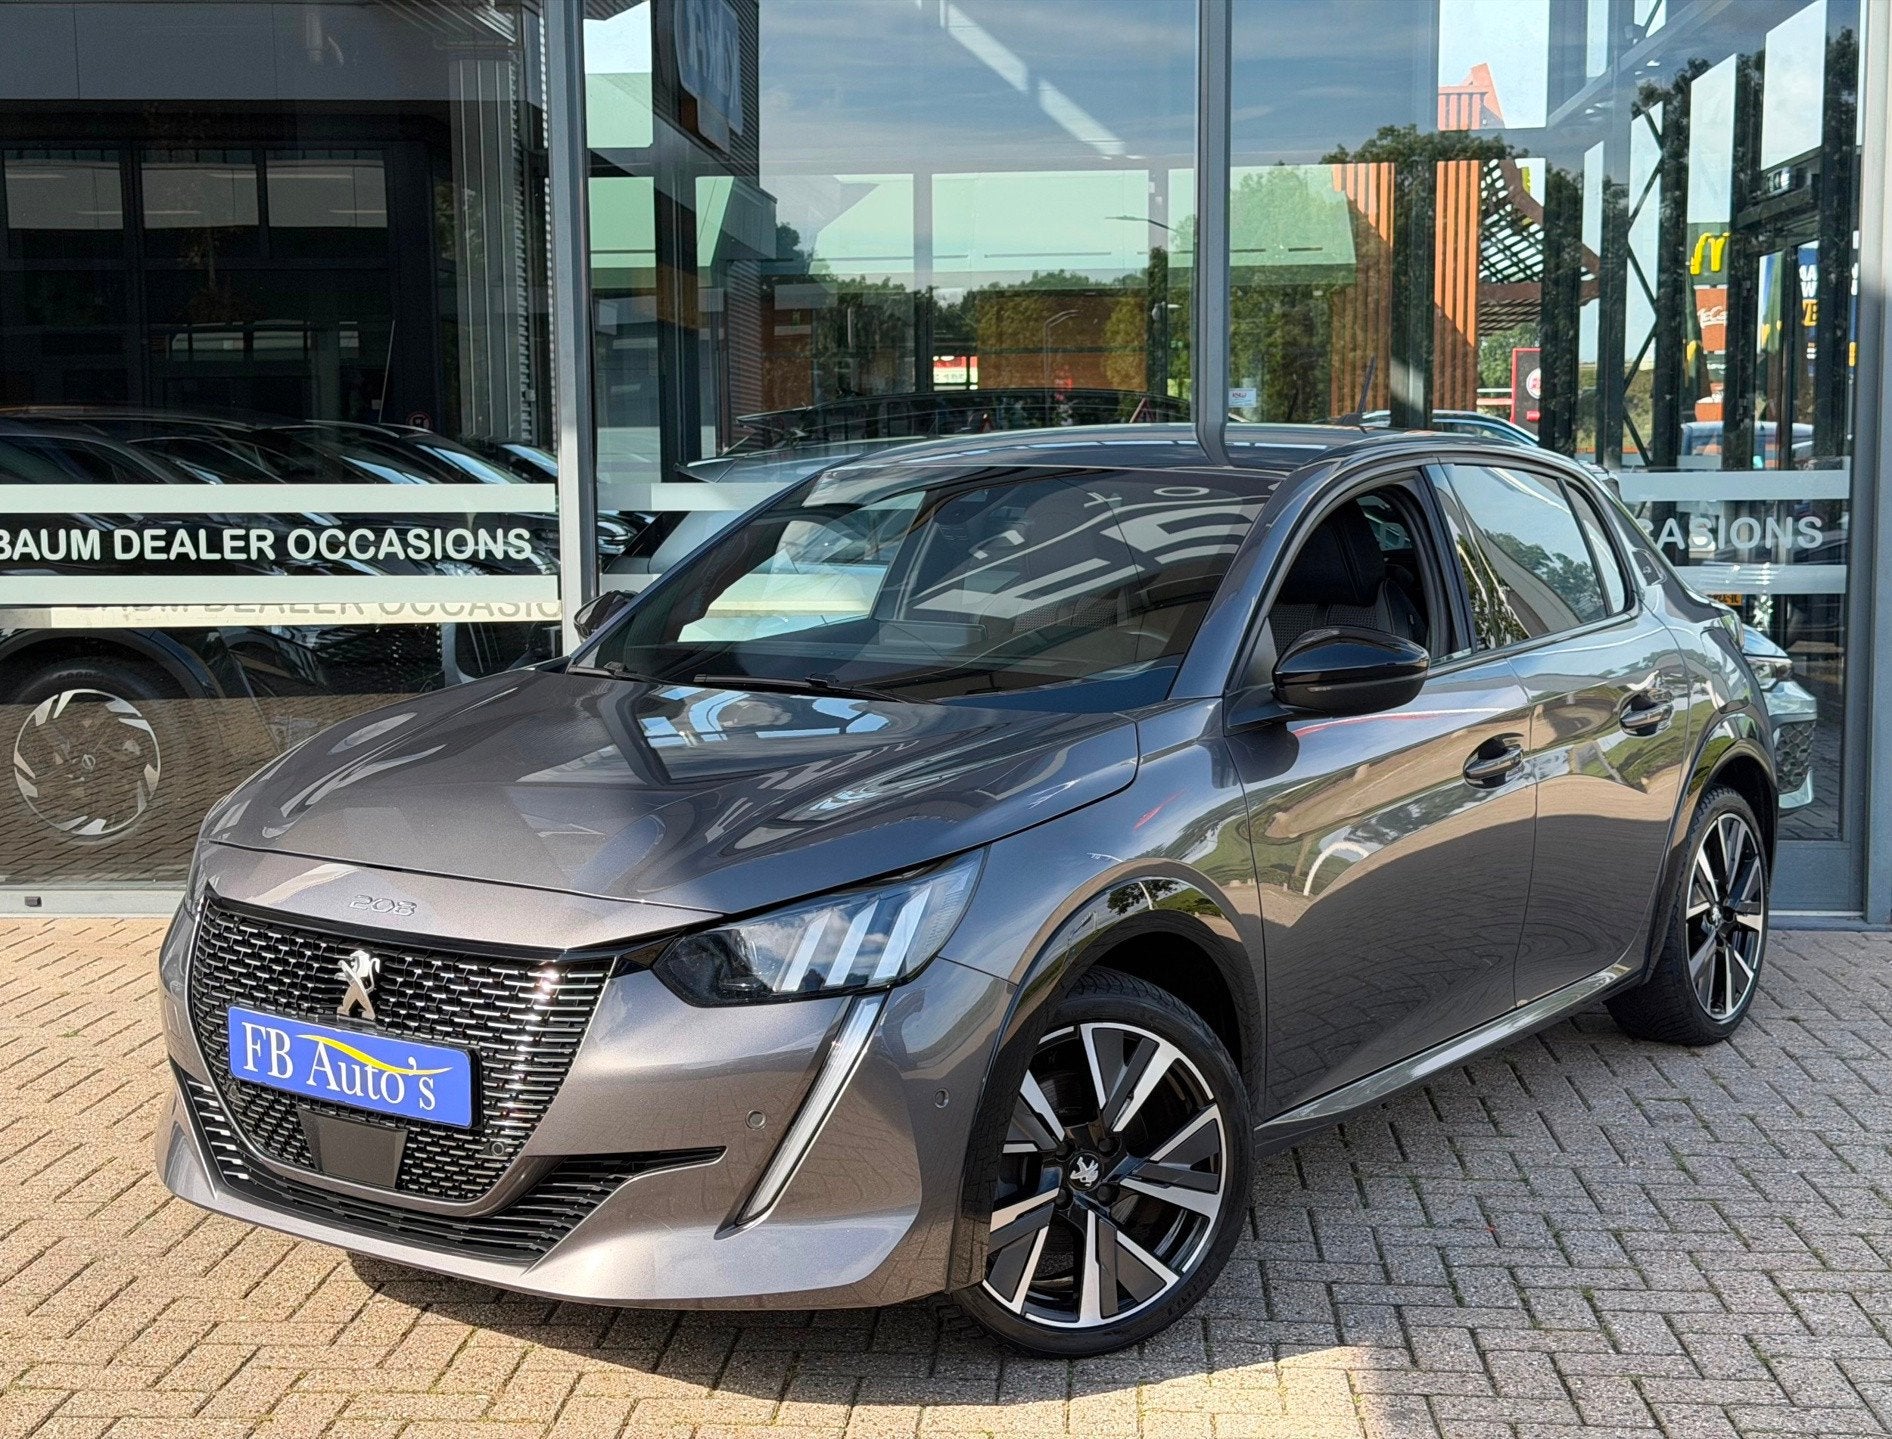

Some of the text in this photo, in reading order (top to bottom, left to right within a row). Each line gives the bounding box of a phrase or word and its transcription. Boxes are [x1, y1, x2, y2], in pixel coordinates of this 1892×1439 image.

[114, 528, 276, 561] DEALER
[287, 528, 532, 561] OCCASIONS
[349, 894, 418, 917] 208
[241, 1021, 436, 1112] FB Auto's
